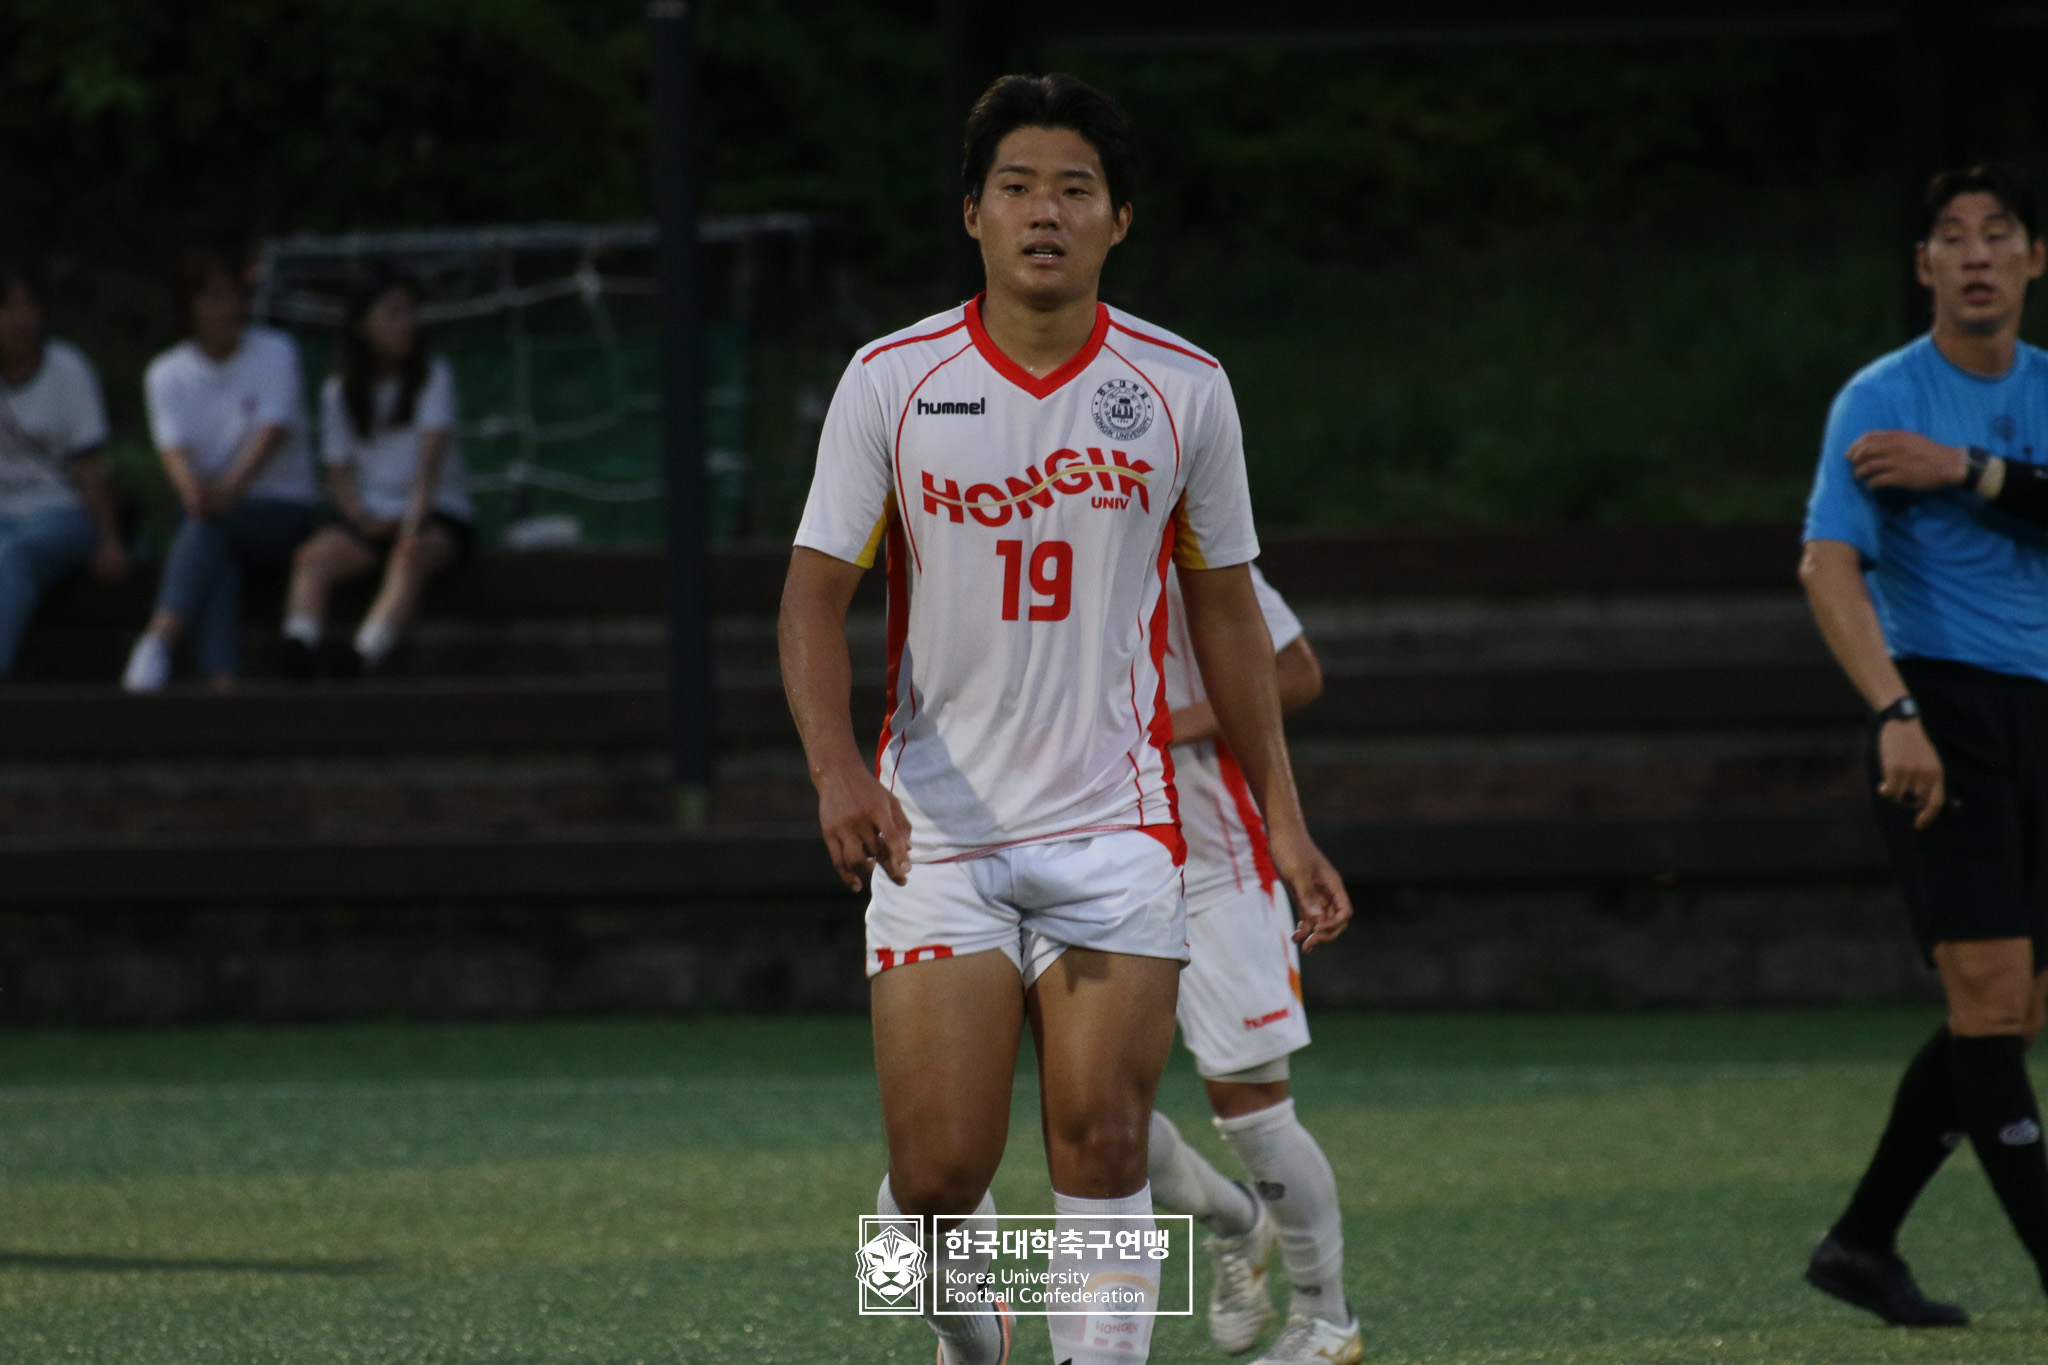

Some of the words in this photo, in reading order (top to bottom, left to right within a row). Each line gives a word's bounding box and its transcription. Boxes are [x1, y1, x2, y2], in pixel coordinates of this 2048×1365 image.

[917, 397, 985, 415] hummel
[921, 447, 1155, 527] HONGIK
[1091, 496, 1130, 511] UNIV
[996, 540, 1073, 621] 19
